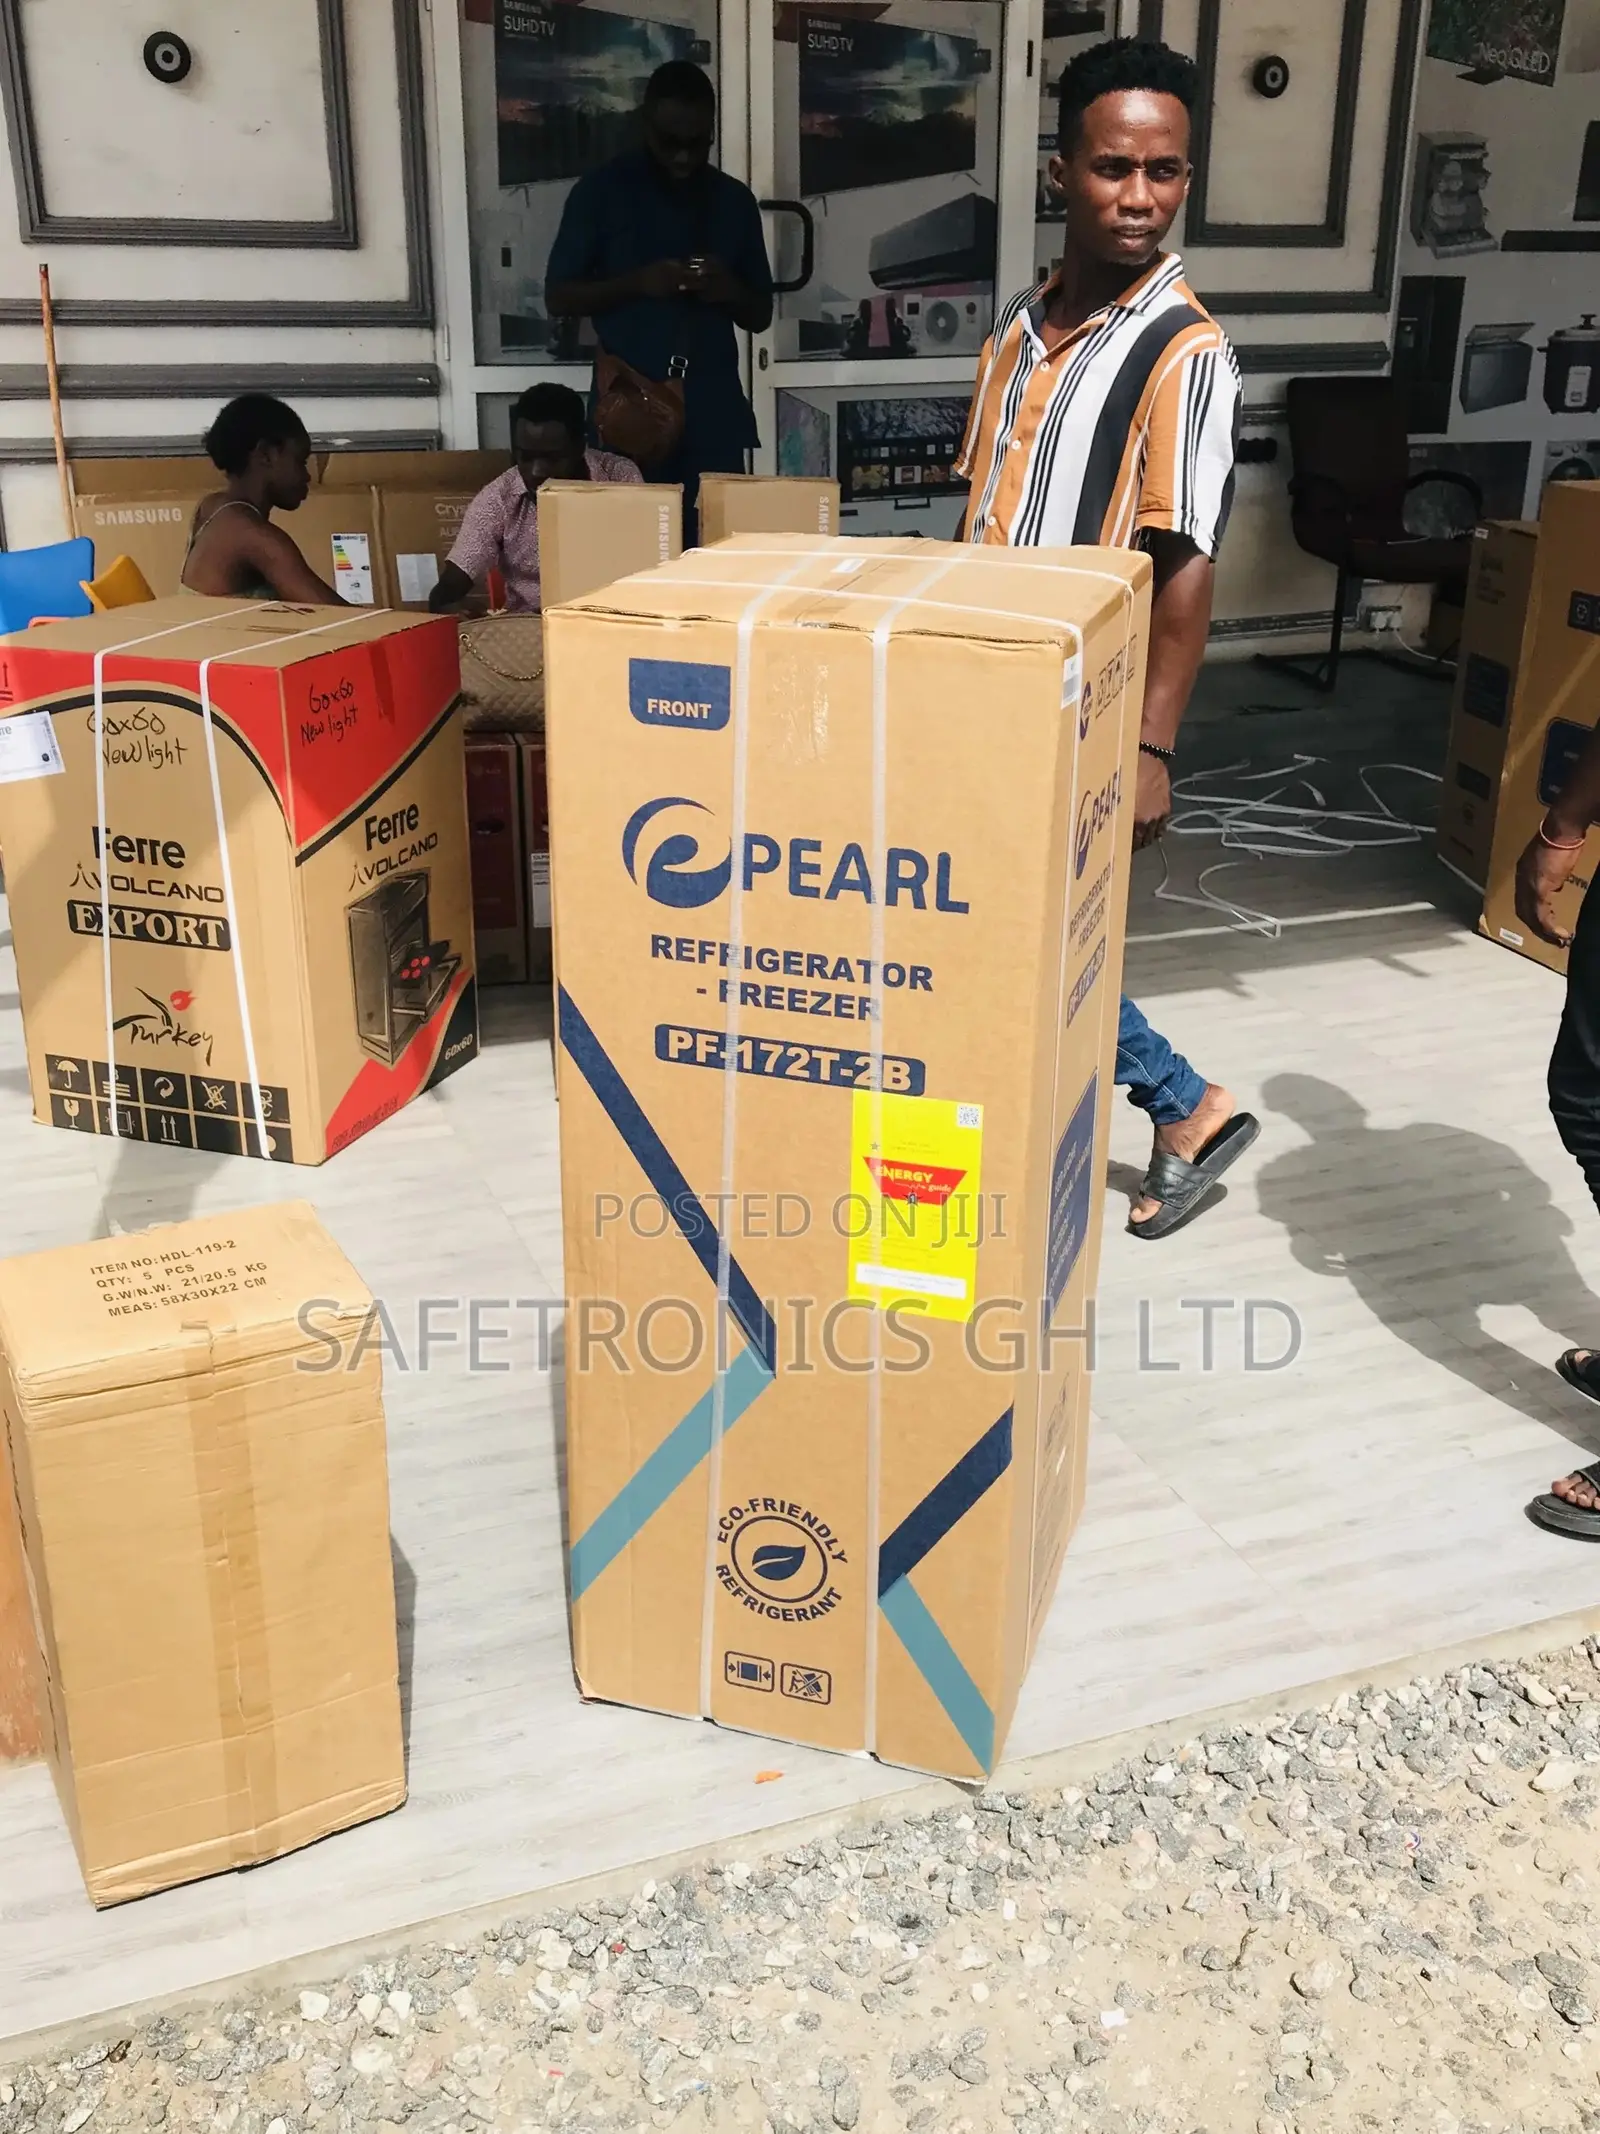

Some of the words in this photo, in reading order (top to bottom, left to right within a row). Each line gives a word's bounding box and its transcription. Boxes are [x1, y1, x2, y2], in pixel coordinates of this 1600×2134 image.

[94, 508, 183, 526] SAMSUNG
[658, 505, 670, 561] SAMSUN
[647, 698, 712, 719] FRONT
[92, 826, 186, 869] Ferre
[365, 803, 419, 852] Ferre
[364, 832, 438, 880] VOLCANO
[742, 832, 970, 915] PEARL
[73, 904, 225, 948] EXPORT
[651, 934, 934, 992] REFRIGERATOR
[719, 978, 881, 1021] FREEZER
[444, 1033, 474, 1061] 60x60
[668, 1029, 912, 1092] PF-172T-2B
[875, 1164, 934, 1184] ENERGY
[90, 1262, 128, 1275] ITEM
[96, 1276, 133, 1288] QTY:
[143, 1271, 153, 1281] 5
[165, 1263, 195, 1276] PCS
[181, 1267, 237, 1287] 21/20.5
[244, 1262, 267, 1273] KG
[243, 1276, 267, 1289] CM
[717, 1497, 848, 1564] ECO-FRIENDLY
[716, 1564, 843, 1622] REFRIGERANT
